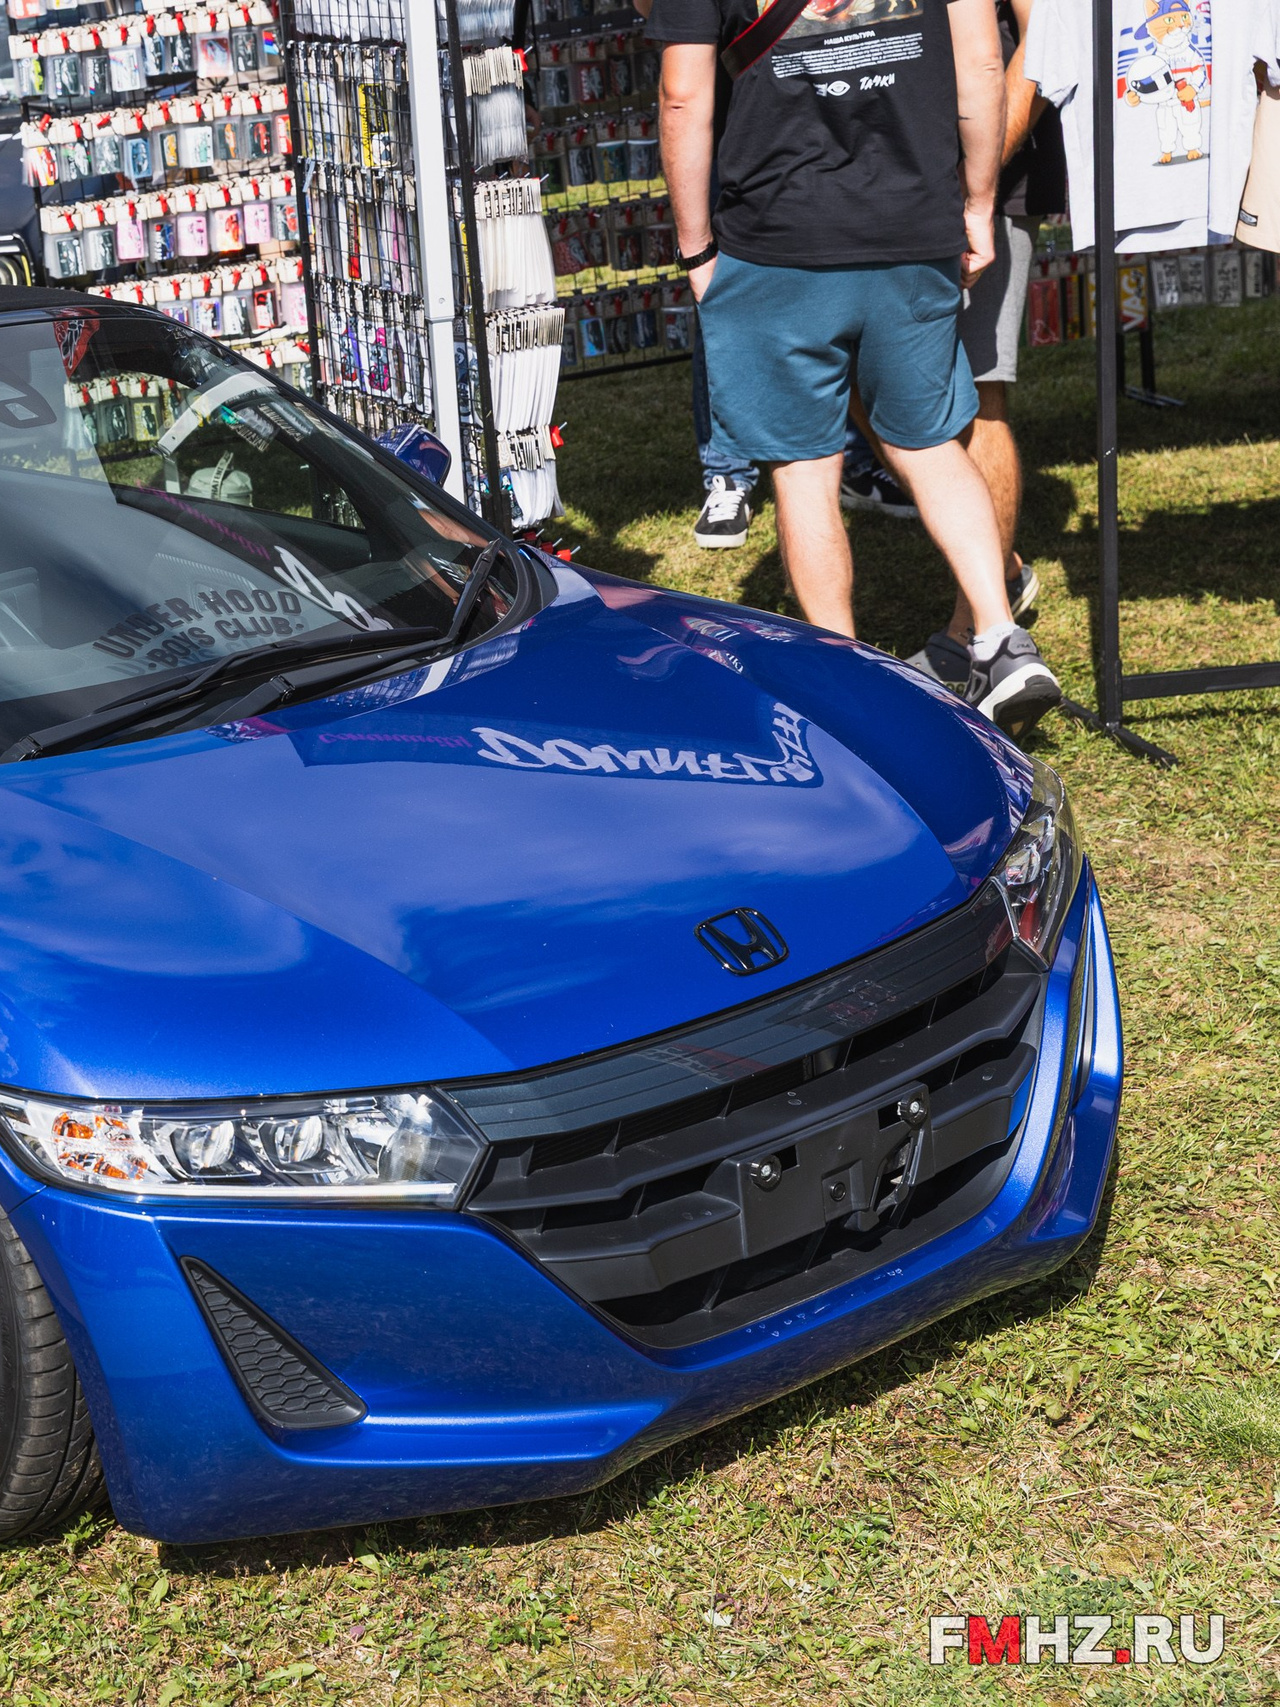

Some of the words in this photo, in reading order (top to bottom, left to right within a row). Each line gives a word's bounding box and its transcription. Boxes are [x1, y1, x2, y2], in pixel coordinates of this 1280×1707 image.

[823, 36, 844, 46] НАША
[844, 30, 876, 43] КУЛЬТУРА
[859, 73, 896, 91] ТАЧКИ
[93, 597, 203, 659] UNDER
[198, 589, 303, 616] HOOD
[147, 626, 216, 668] BOYS
[214, 615, 293, 641] CLUB
